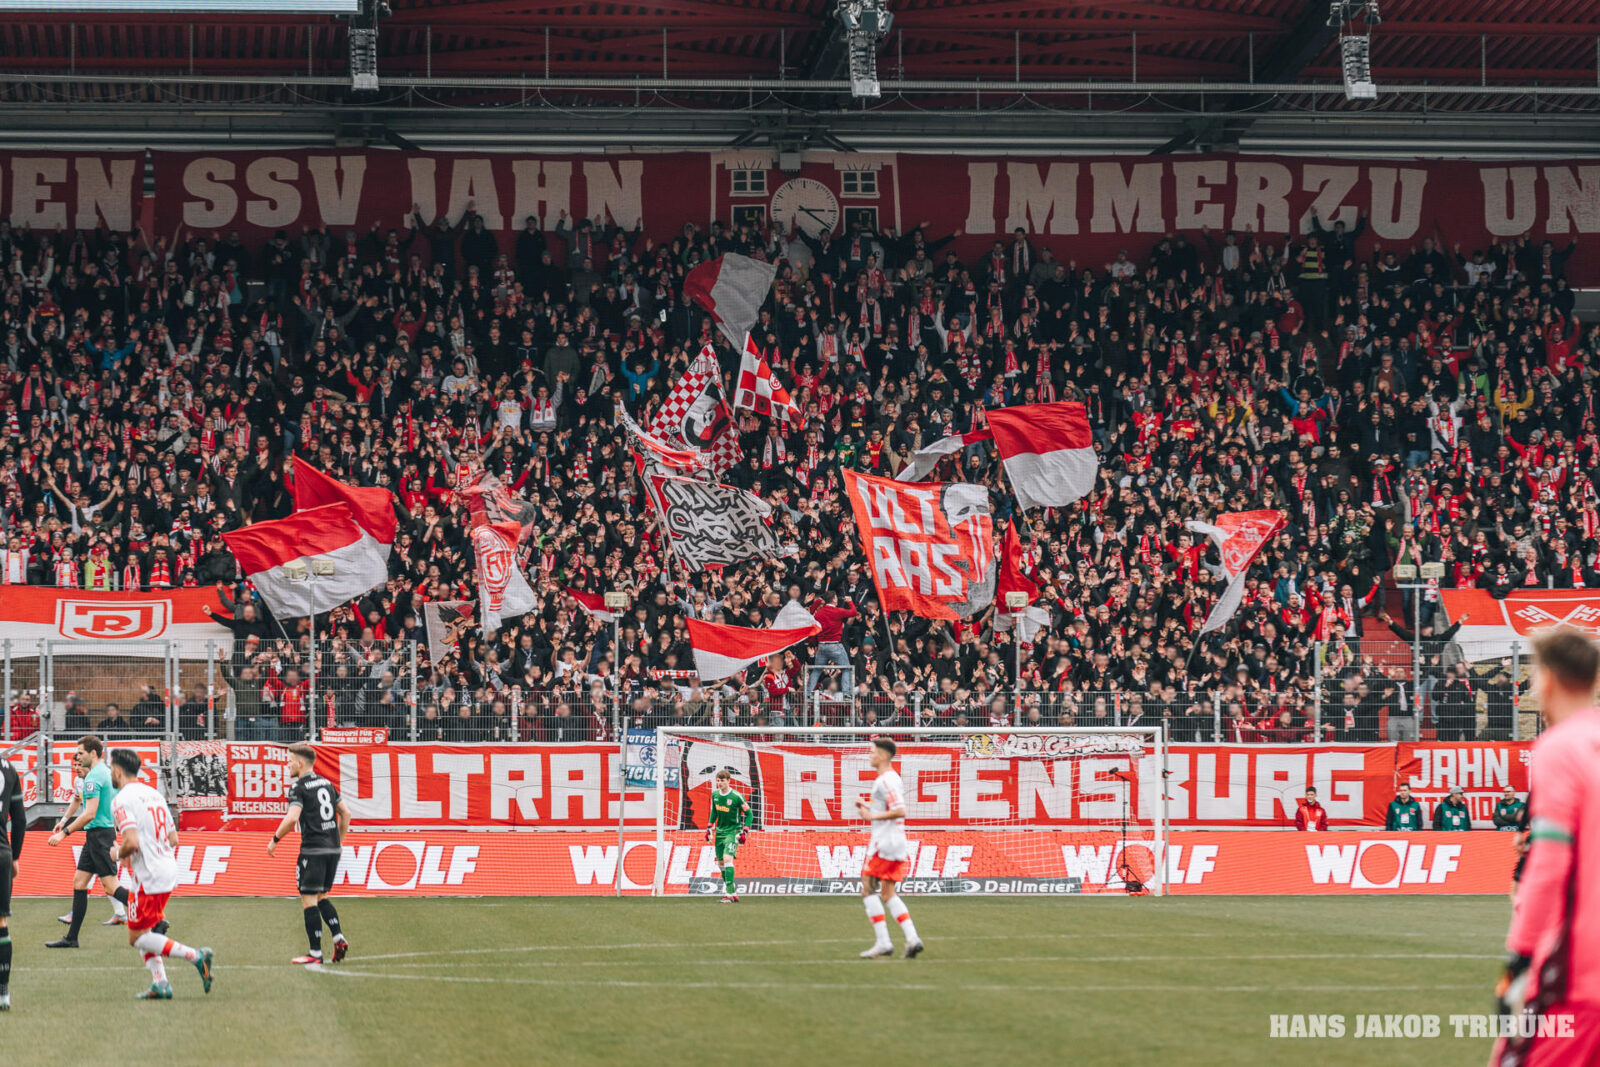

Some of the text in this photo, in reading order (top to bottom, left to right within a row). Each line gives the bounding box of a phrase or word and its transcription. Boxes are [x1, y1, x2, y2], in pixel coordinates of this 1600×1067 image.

[0, 157, 135, 232] EN
[182, 155, 366, 227] SSV
[404, 158, 643, 231] JAHN
[965, 161, 1427, 239] IMMERZU
[856, 476, 936, 535] ULT
[873, 537, 963, 596] RAS
[231, 745, 258, 760] SSV
[264, 746, 290, 762] JAH
[1408, 748, 1509, 789] JAHN
[233, 801, 290, 814] REGENSBU
[317, 788, 334, 821] 8
[339, 753, 1365, 820] ULTRAS REGENSBURG
[816, 840, 973, 878] WLF
[1061, 840, 1219, 889] WOLF
[1305, 840, 1462, 889] WOLF
[984, 879, 1075, 894] Dallmeier
